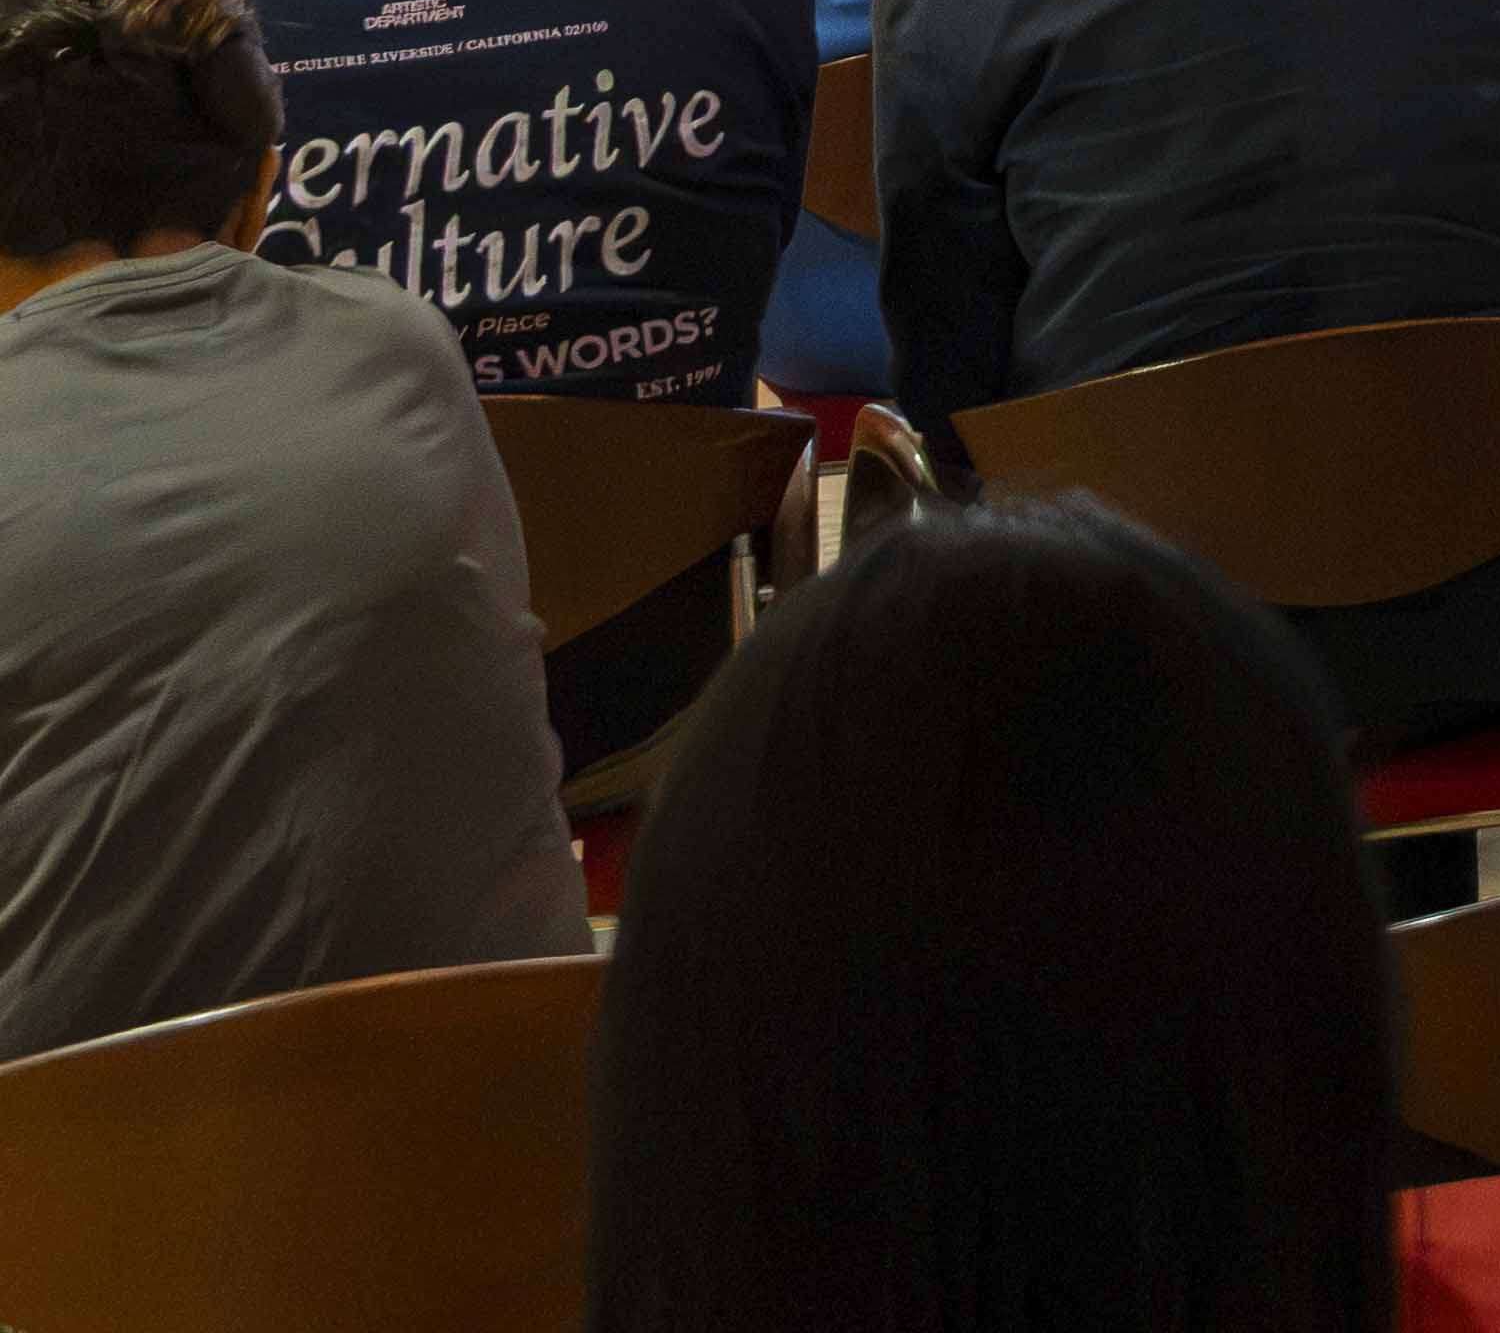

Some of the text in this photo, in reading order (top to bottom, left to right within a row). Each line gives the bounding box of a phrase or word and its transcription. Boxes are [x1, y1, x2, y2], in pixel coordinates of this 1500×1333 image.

[294, 53, 367, 72] CULTURE
[466, 27, 562, 52] CALIFORNIA
[476, 311, 551, 339] Place
[516, 305, 719, 379] WORDS?
